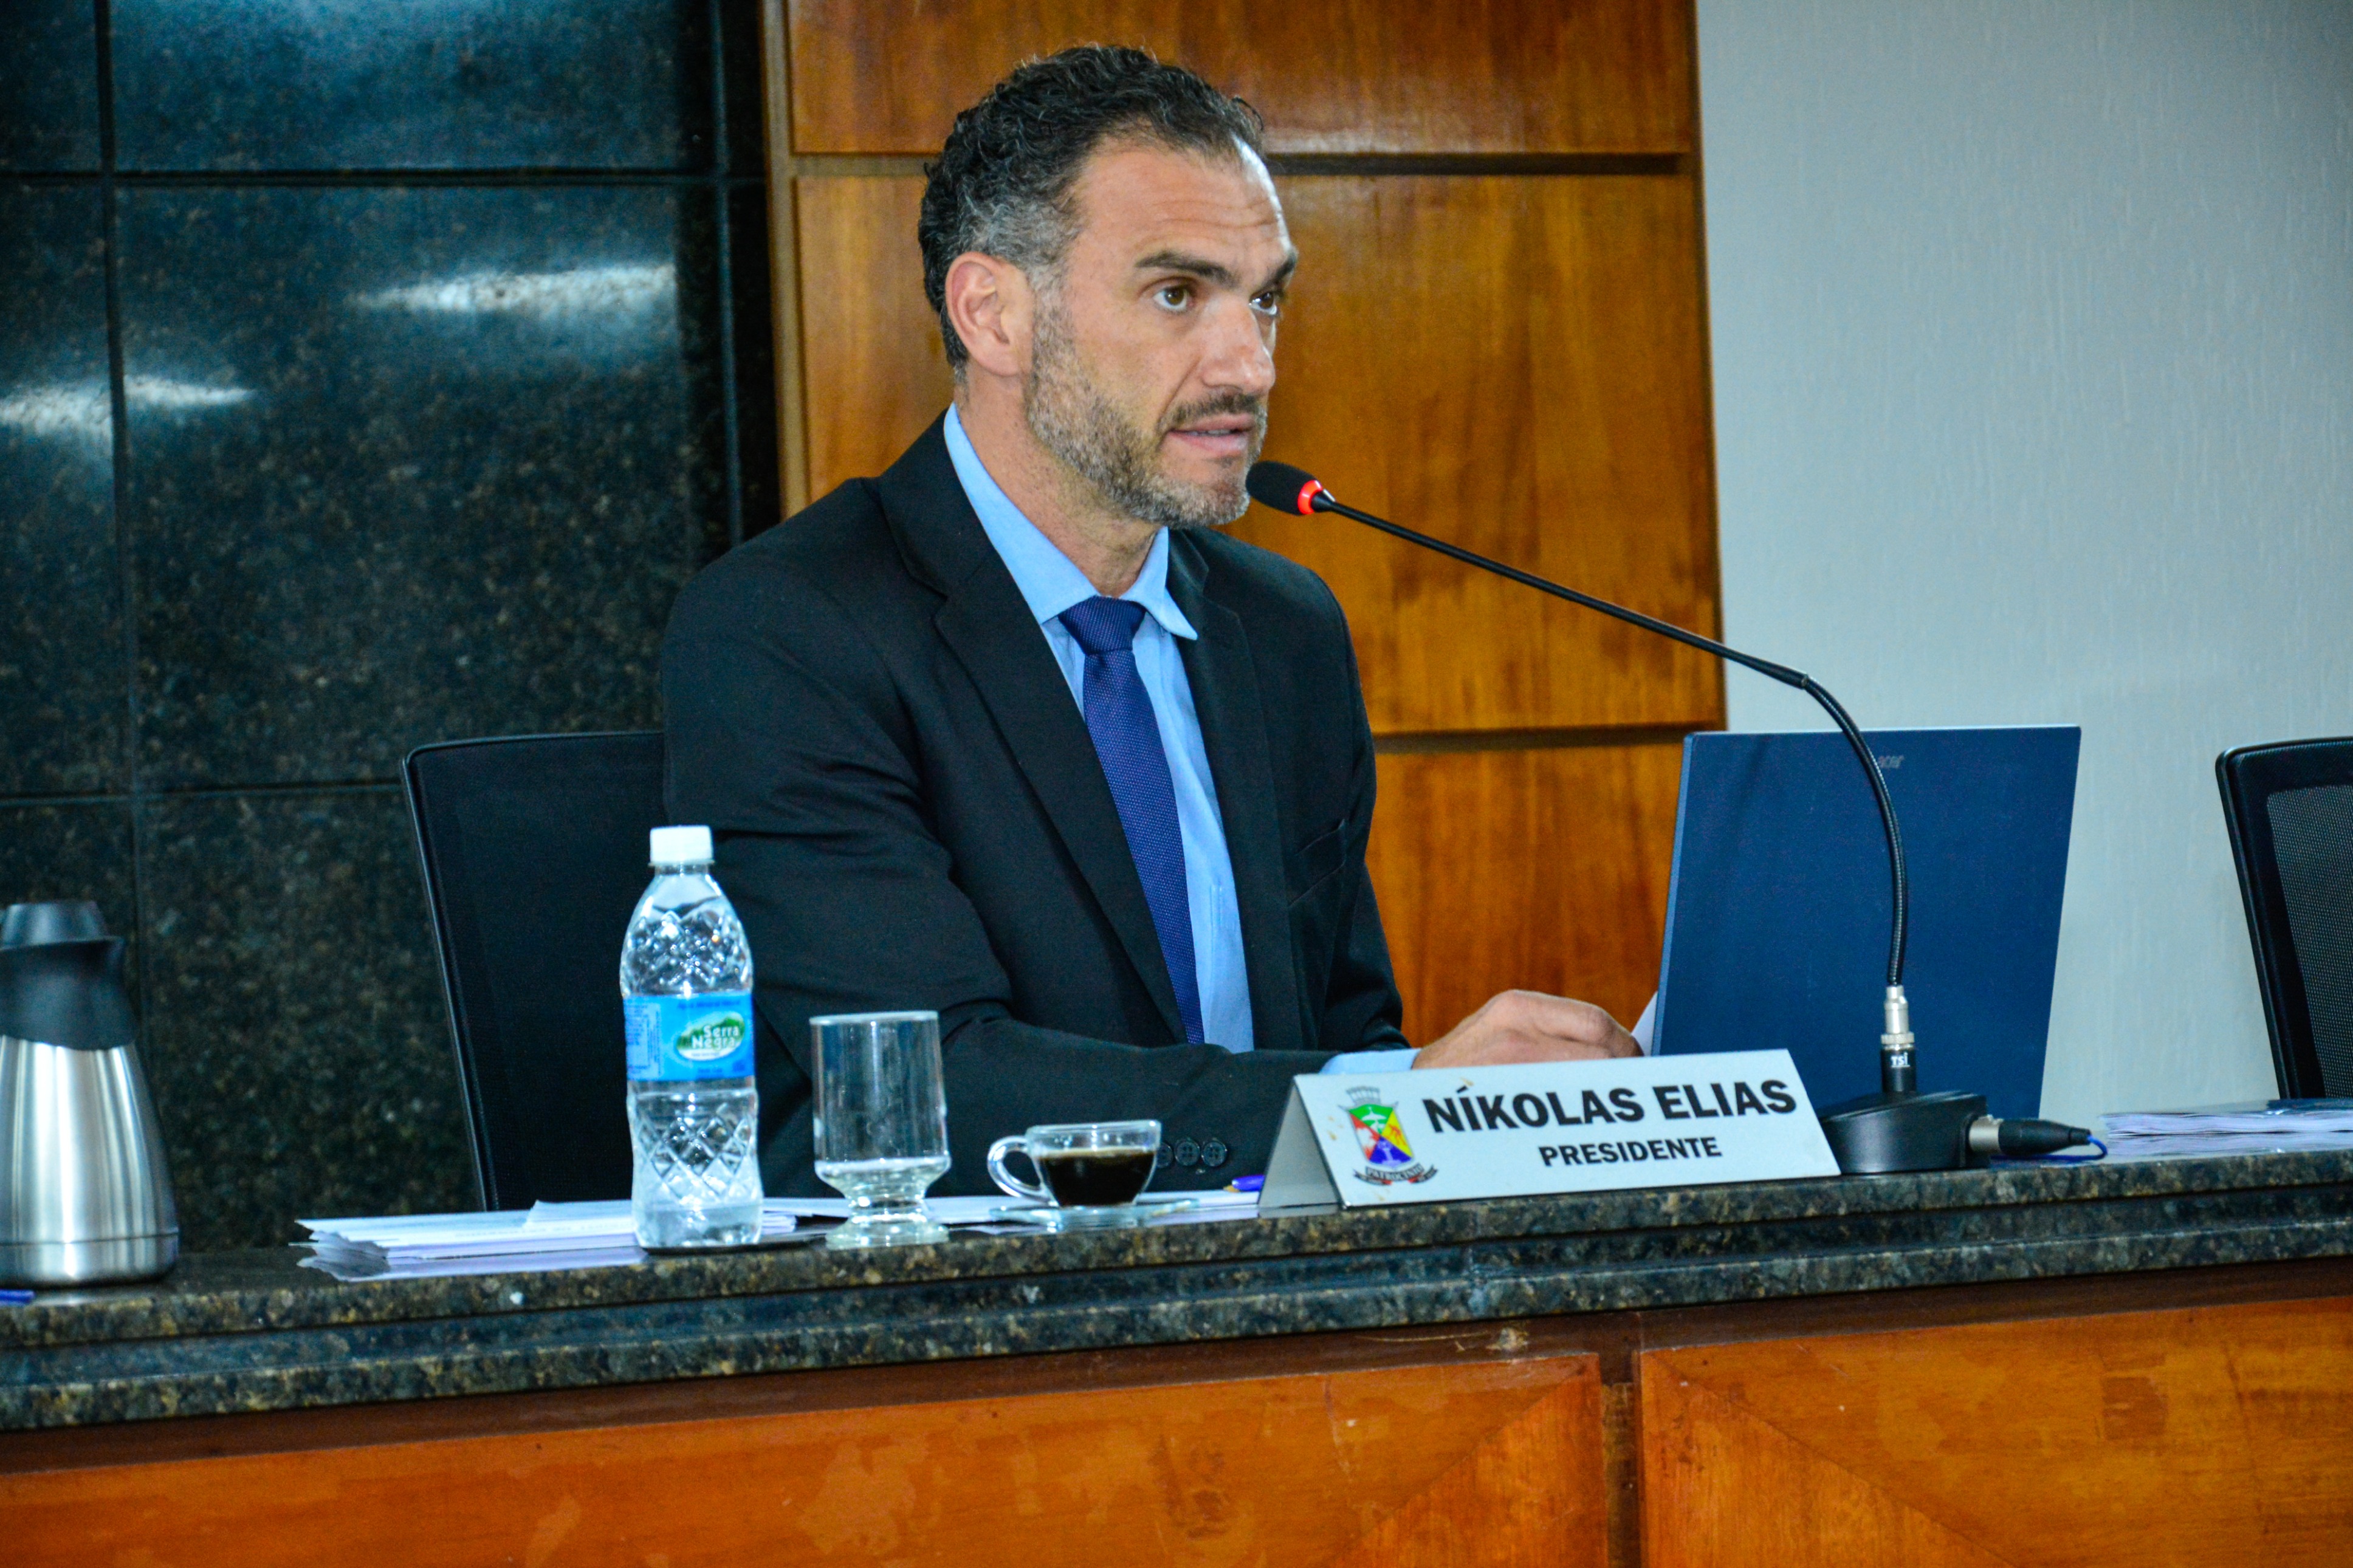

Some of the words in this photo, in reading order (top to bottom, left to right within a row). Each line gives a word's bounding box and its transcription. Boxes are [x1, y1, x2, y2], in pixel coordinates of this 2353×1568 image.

[704, 1025, 740, 1038] Serra
[692, 1035, 736, 1052] Negra
[1422, 1084, 1644, 1134] NÍKOLAS
[1652, 1079, 1797, 1120] ELIAS
[1538, 1137, 1722, 1167] PRESIDENTE
